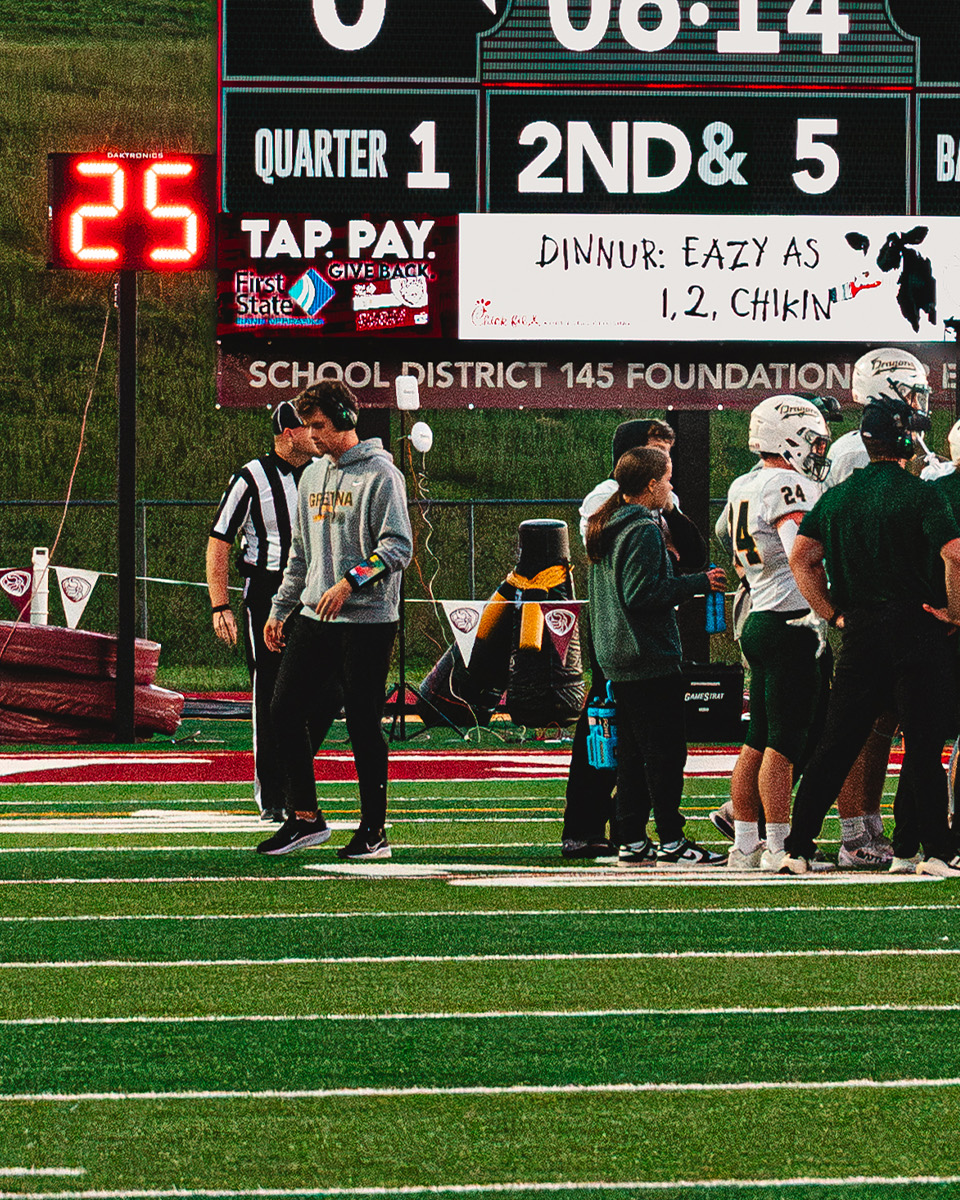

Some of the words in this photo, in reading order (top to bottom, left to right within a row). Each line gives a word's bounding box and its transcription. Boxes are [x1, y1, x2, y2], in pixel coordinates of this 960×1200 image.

[106, 151, 164, 159] DAKTRONICS
[254, 127, 389, 185] QUARTER
[406, 120, 450, 190] 1
[791, 118, 841, 195] 5
[69, 161, 198, 261] 25
[240, 219, 335, 259] TAP.
[348, 219, 437, 260] PAY.
[535, 233, 665, 271] DINNUR:
[681, 236, 768, 271] EAZY
[782, 238, 820, 269] AS
[235, 271, 286, 293] First
[328, 263, 375, 279] GIVE
[235, 294, 294, 316] State
[730, 287, 832, 322] CHIKIN
[248, 360, 390, 390] SCHOOL
[402, 360, 548, 390] DISTRICT
[559, 361, 615, 389] 145
[627, 361, 849, 391] FOUNDATION
[780, 484, 807, 505] 24
